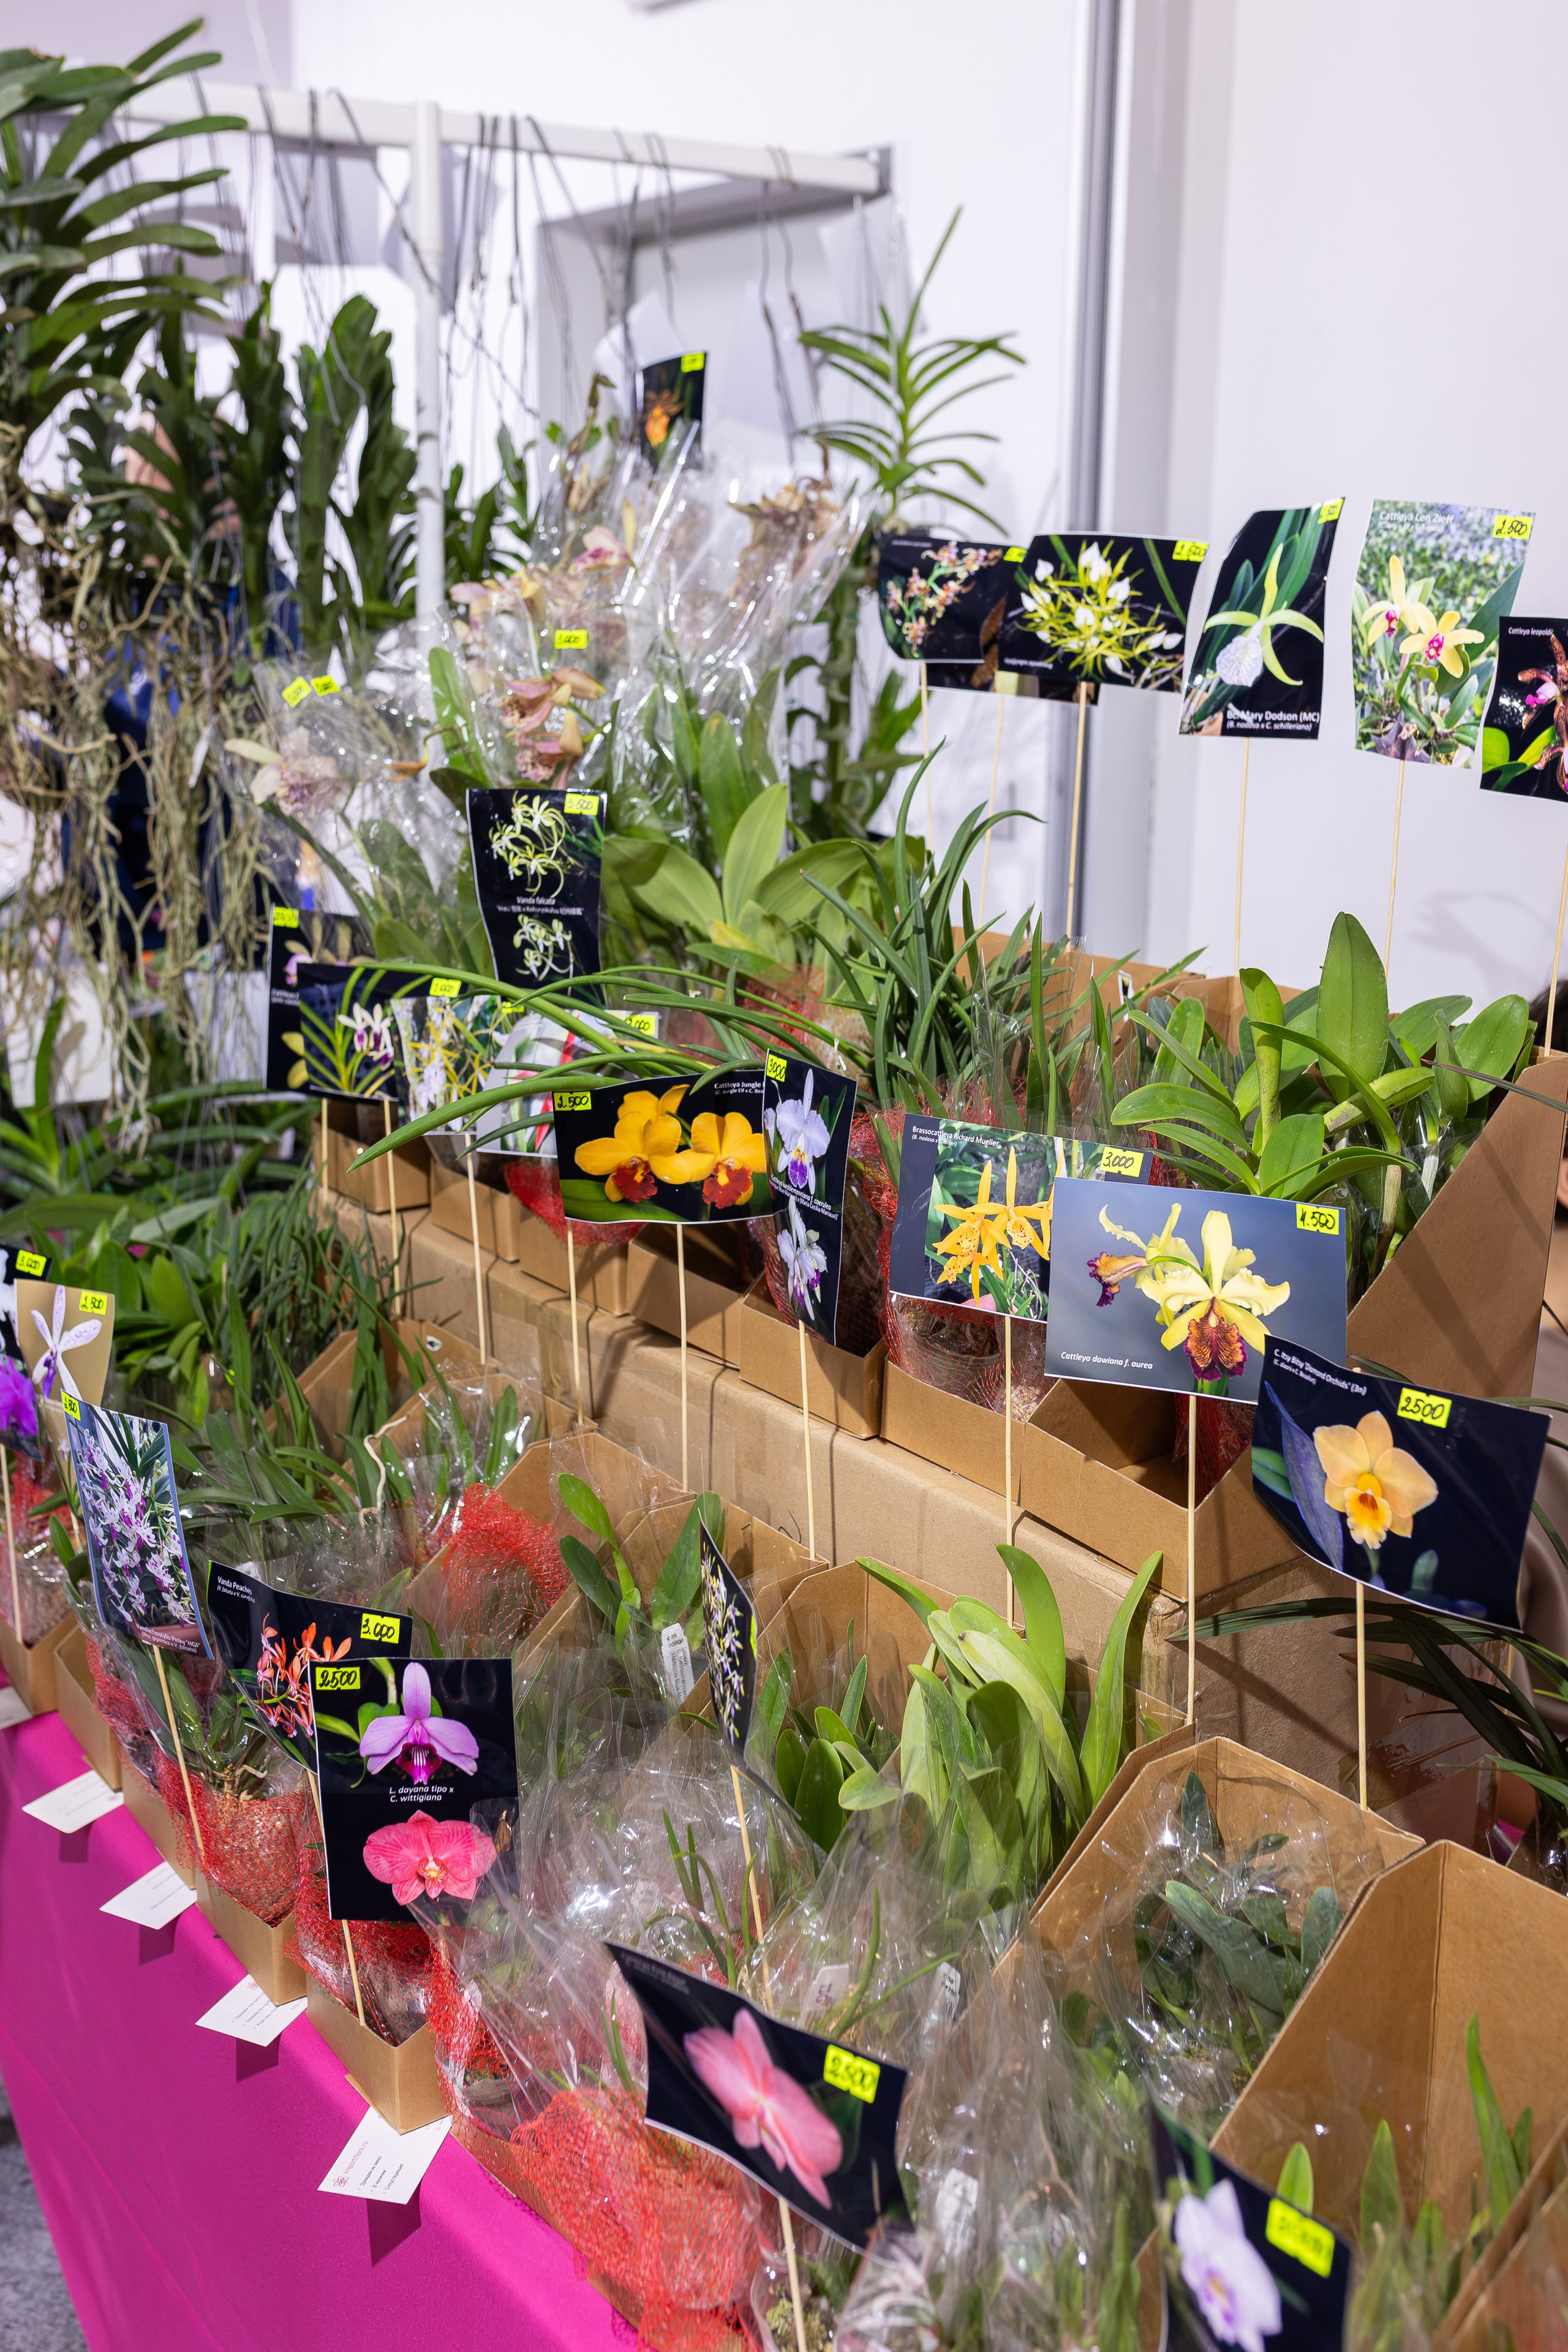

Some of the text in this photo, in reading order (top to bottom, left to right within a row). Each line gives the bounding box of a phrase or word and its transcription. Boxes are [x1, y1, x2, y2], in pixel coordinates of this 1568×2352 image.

[1508, 627, 1530, 636] Cattleya
[1265, 710, 1298, 722] Dodson
[1299, 712, 1321, 723] (MC)
[912, 1126, 1000, 1147] Brassocattleya Richard Mueller
[919, 1134, 935, 1143] nodosa
[1060, 1351, 1153, 1370] Cattleya dowiana f. aurea
[1401, 1396, 1445, 1420] 2500
[217, 1575, 252, 1596] Vanda Peaches
[362, 1618, 395, 1639] 3.000
[171, 1635, 186, 1646] Pinky
[318, 1670, 357, 1689] 2500
[398, 1785, 429, 1795] dayana
[431, 1784, 448, 1794] tipo
[400, 1793, 442, 1803] wittigiana
